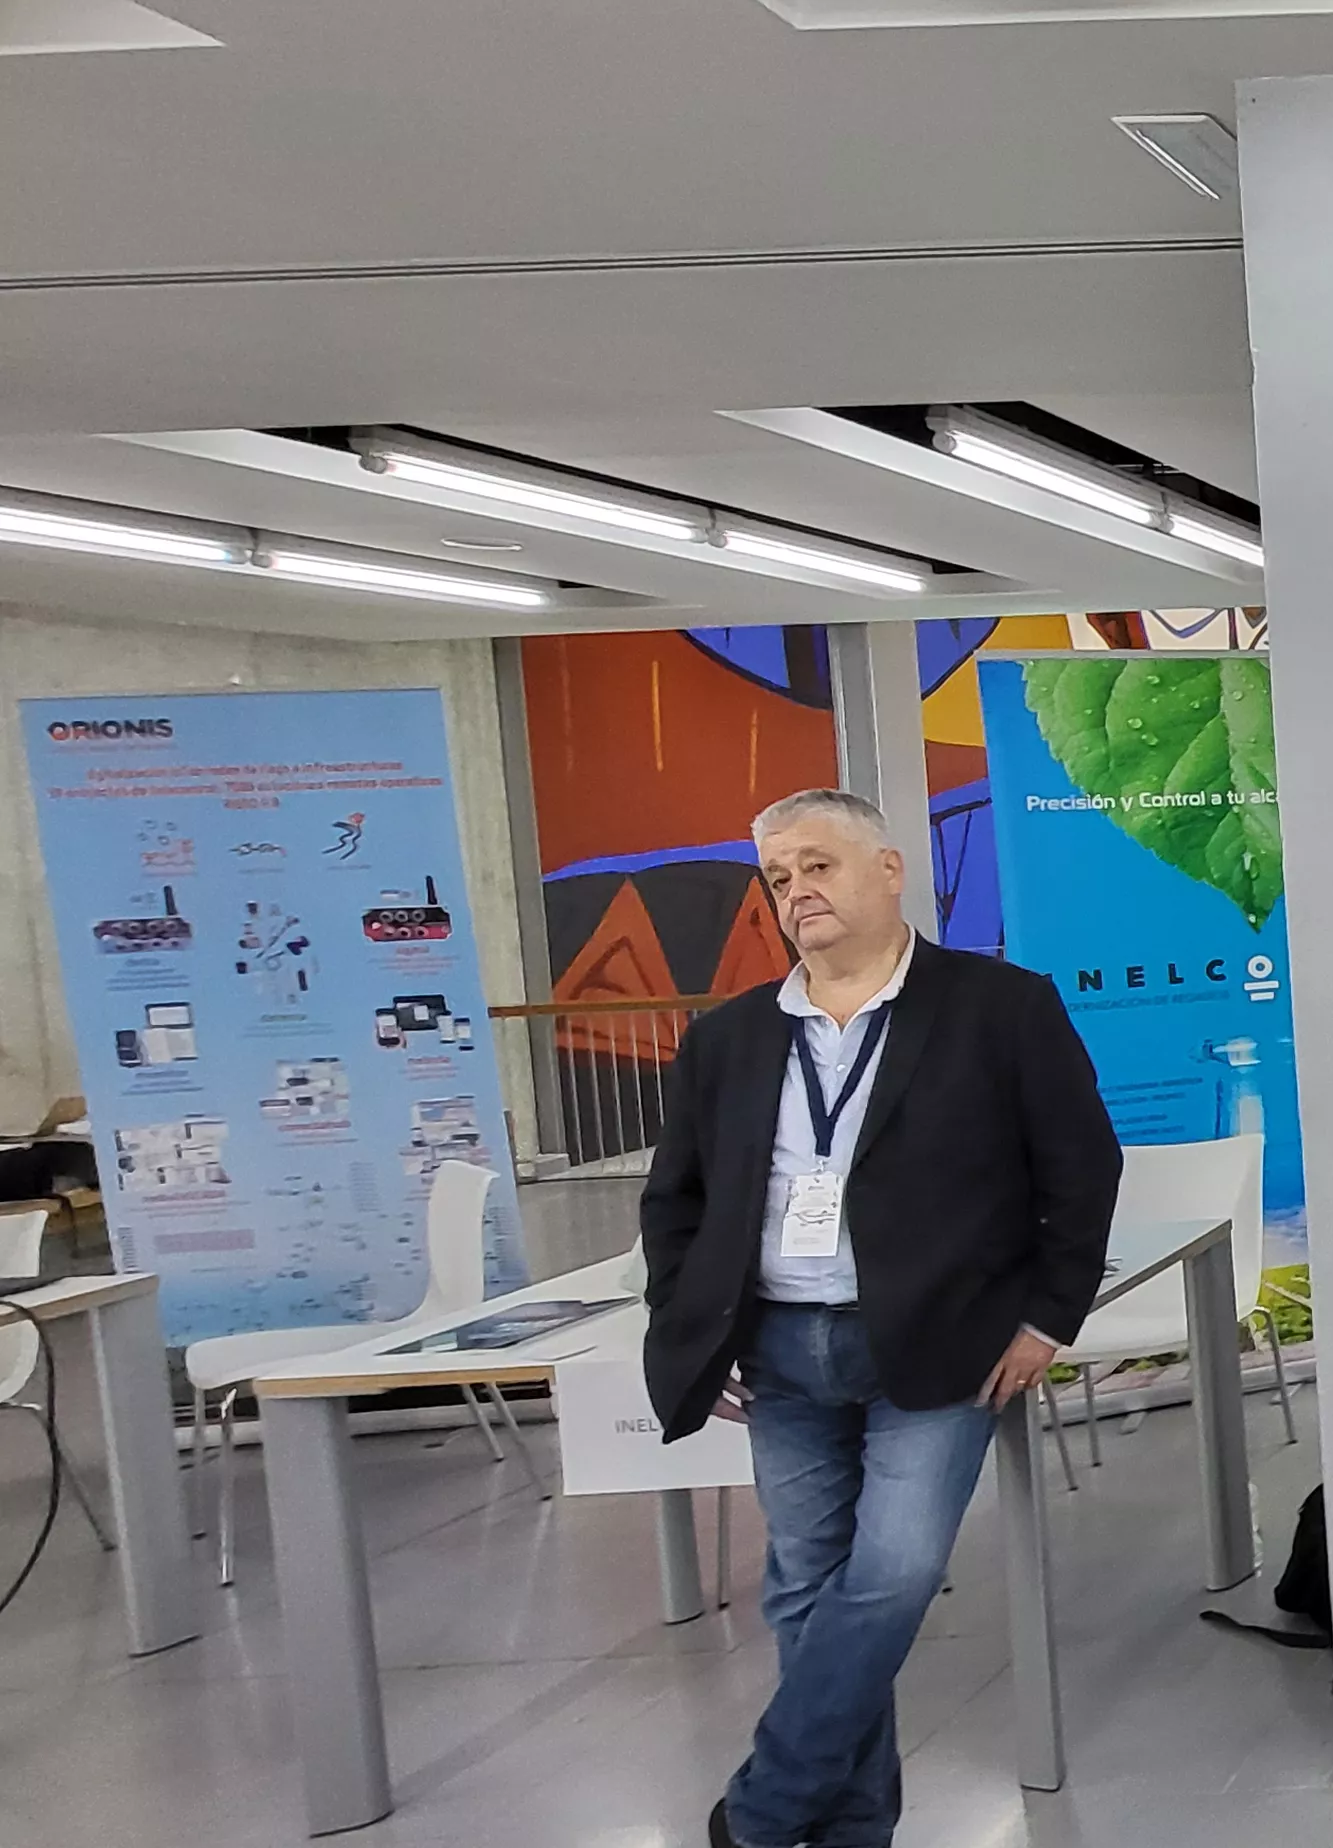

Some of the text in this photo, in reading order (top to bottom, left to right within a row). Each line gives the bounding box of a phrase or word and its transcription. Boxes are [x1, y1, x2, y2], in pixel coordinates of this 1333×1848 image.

[47, 718, 173, 741] ORIONIS
[1027, 794, 1116, 811] Precisión
[1121, 797, 1133, 812] y
[1139, 791, 1206, 808] Control
[1211, 793, 1222, 805] a
[1226, 791, 1244, 804] tu
[1046, 955, 1279, 992] NELCO
[615, 1418, 659, 1433] INEL
